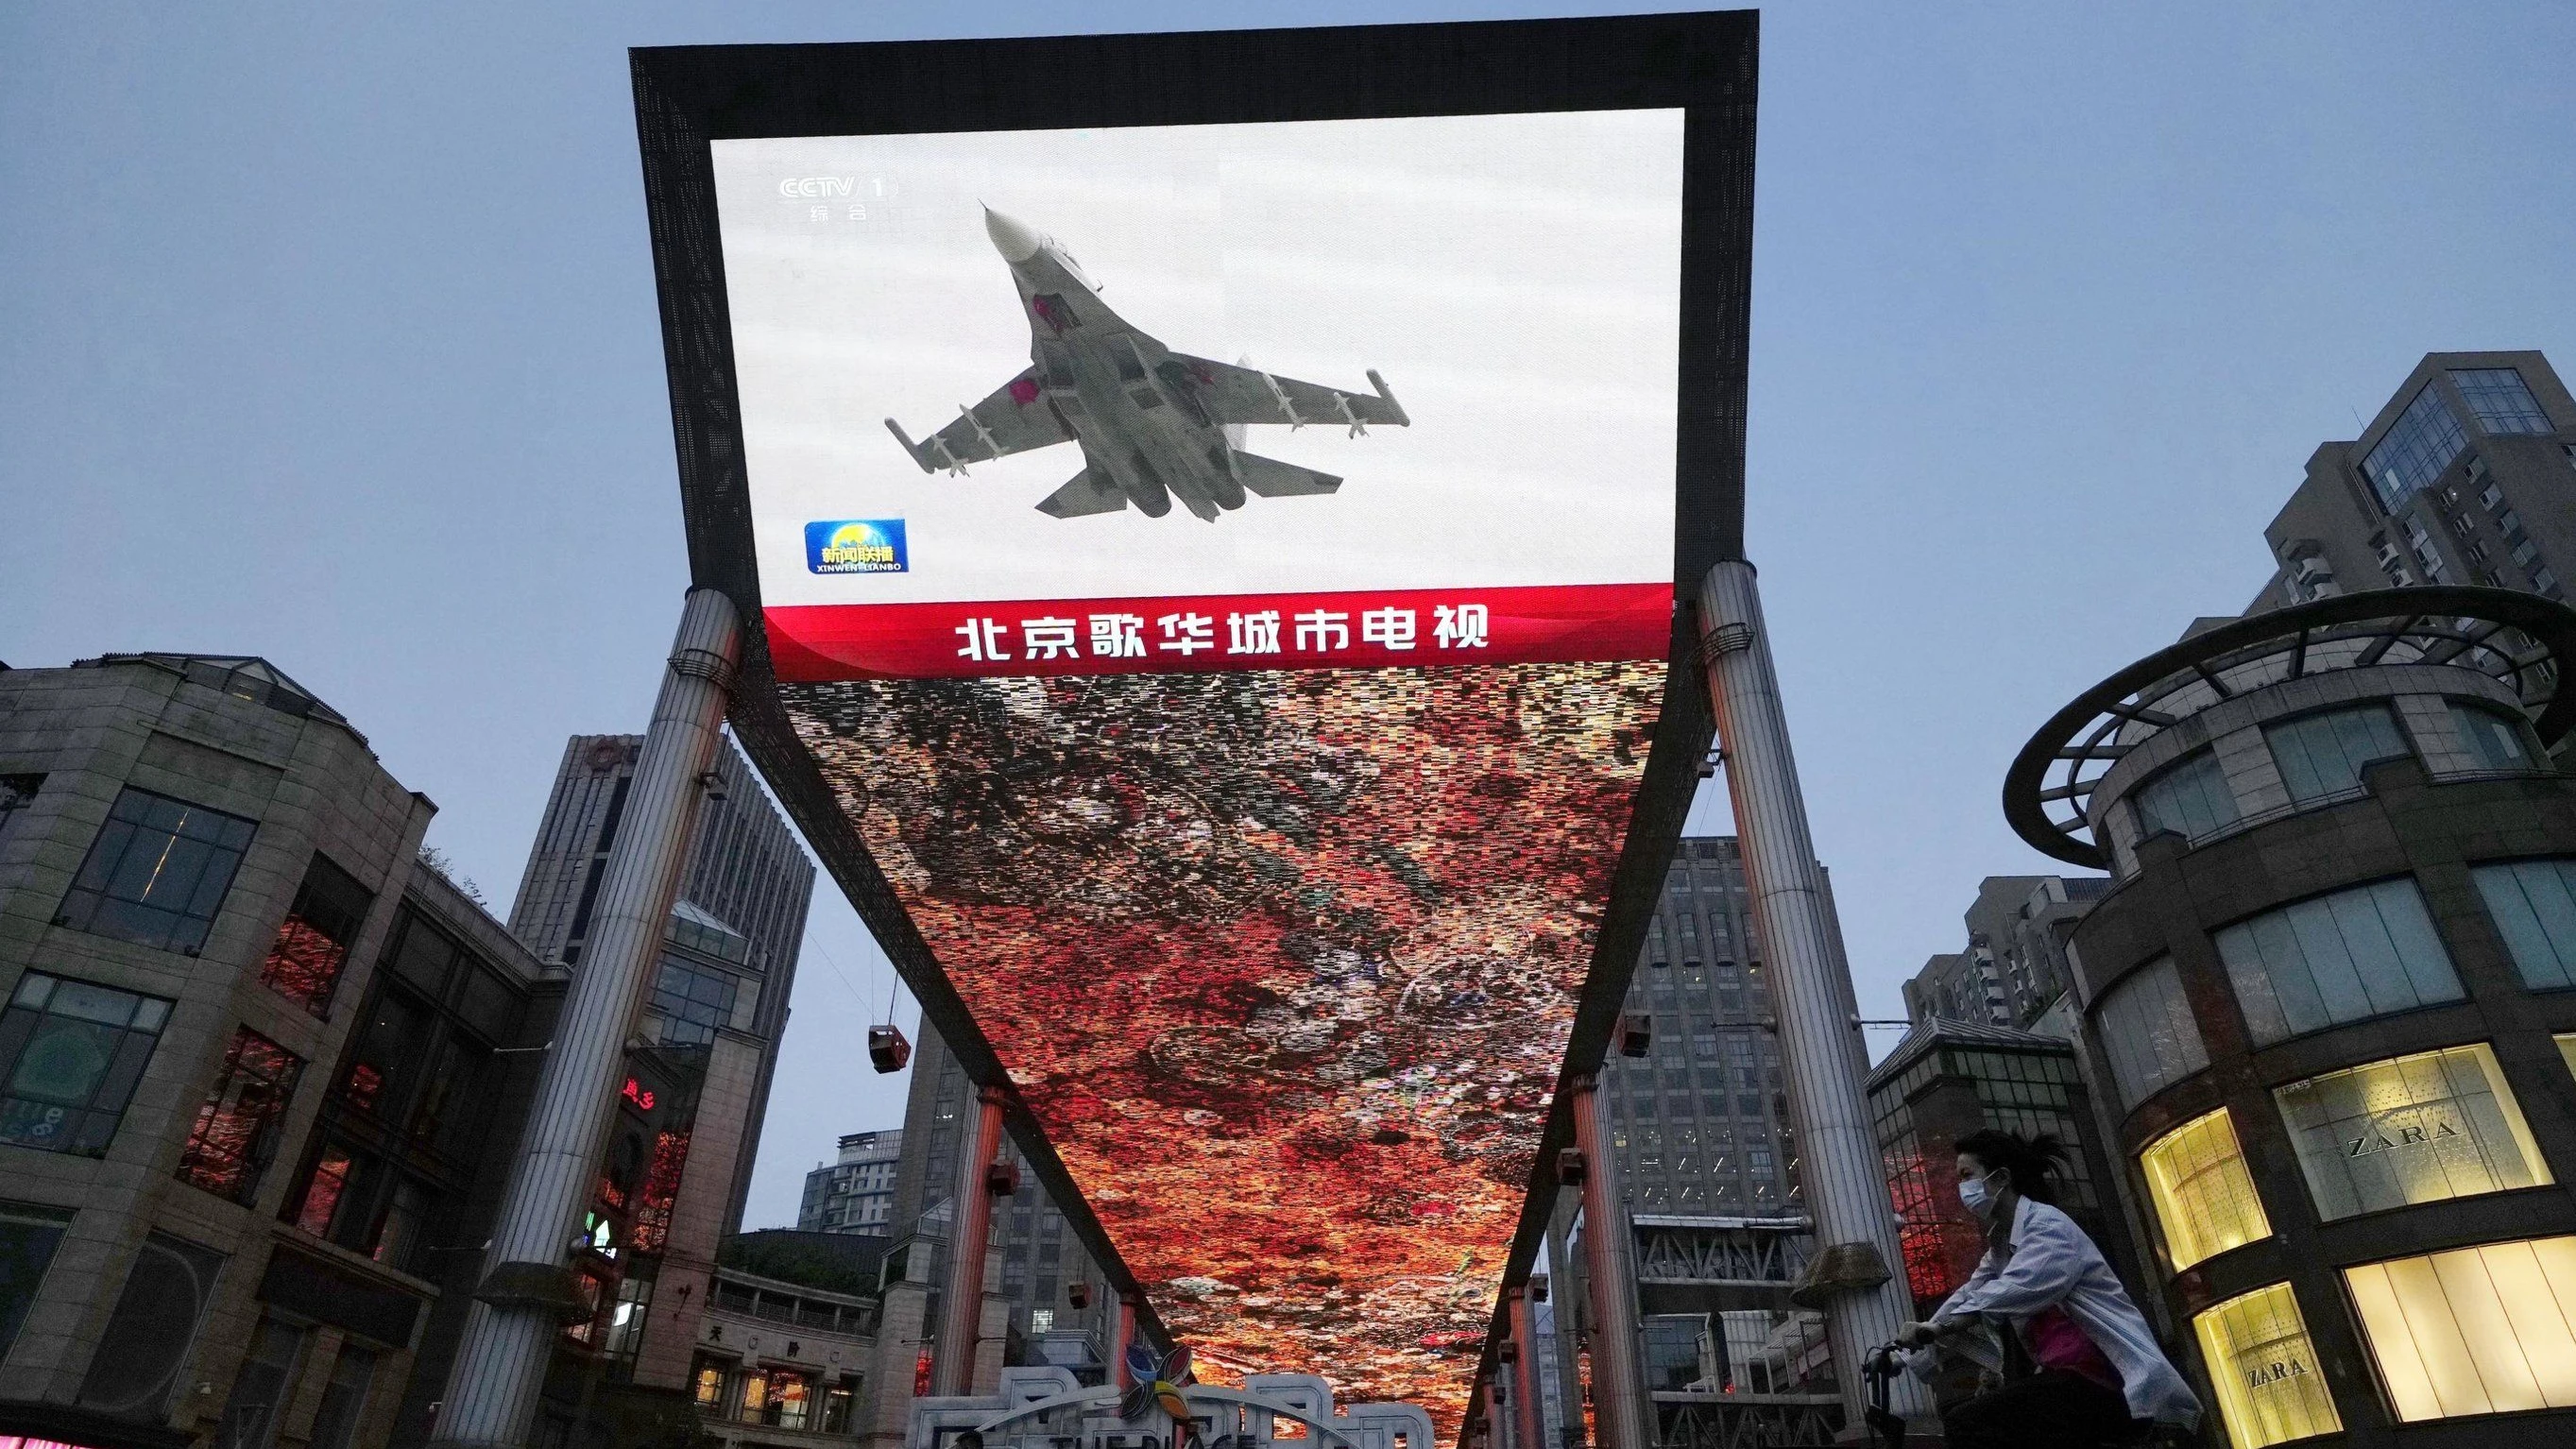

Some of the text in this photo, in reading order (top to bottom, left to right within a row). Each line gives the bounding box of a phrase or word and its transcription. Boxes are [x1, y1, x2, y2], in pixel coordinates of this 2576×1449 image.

[779, 177, 883, 197] CCTV 1
[810, 204, 867, 221] 综合
[822, 546, 894, 563] 新闻联播
[864, 563, 902, 571] LIANBO
[955, 604, 1490, 661] 北京歌华城市电视
[2346, 1121, 2460, 1158] ZARA
[2248, 1358, 2308, 1389] ZARA
